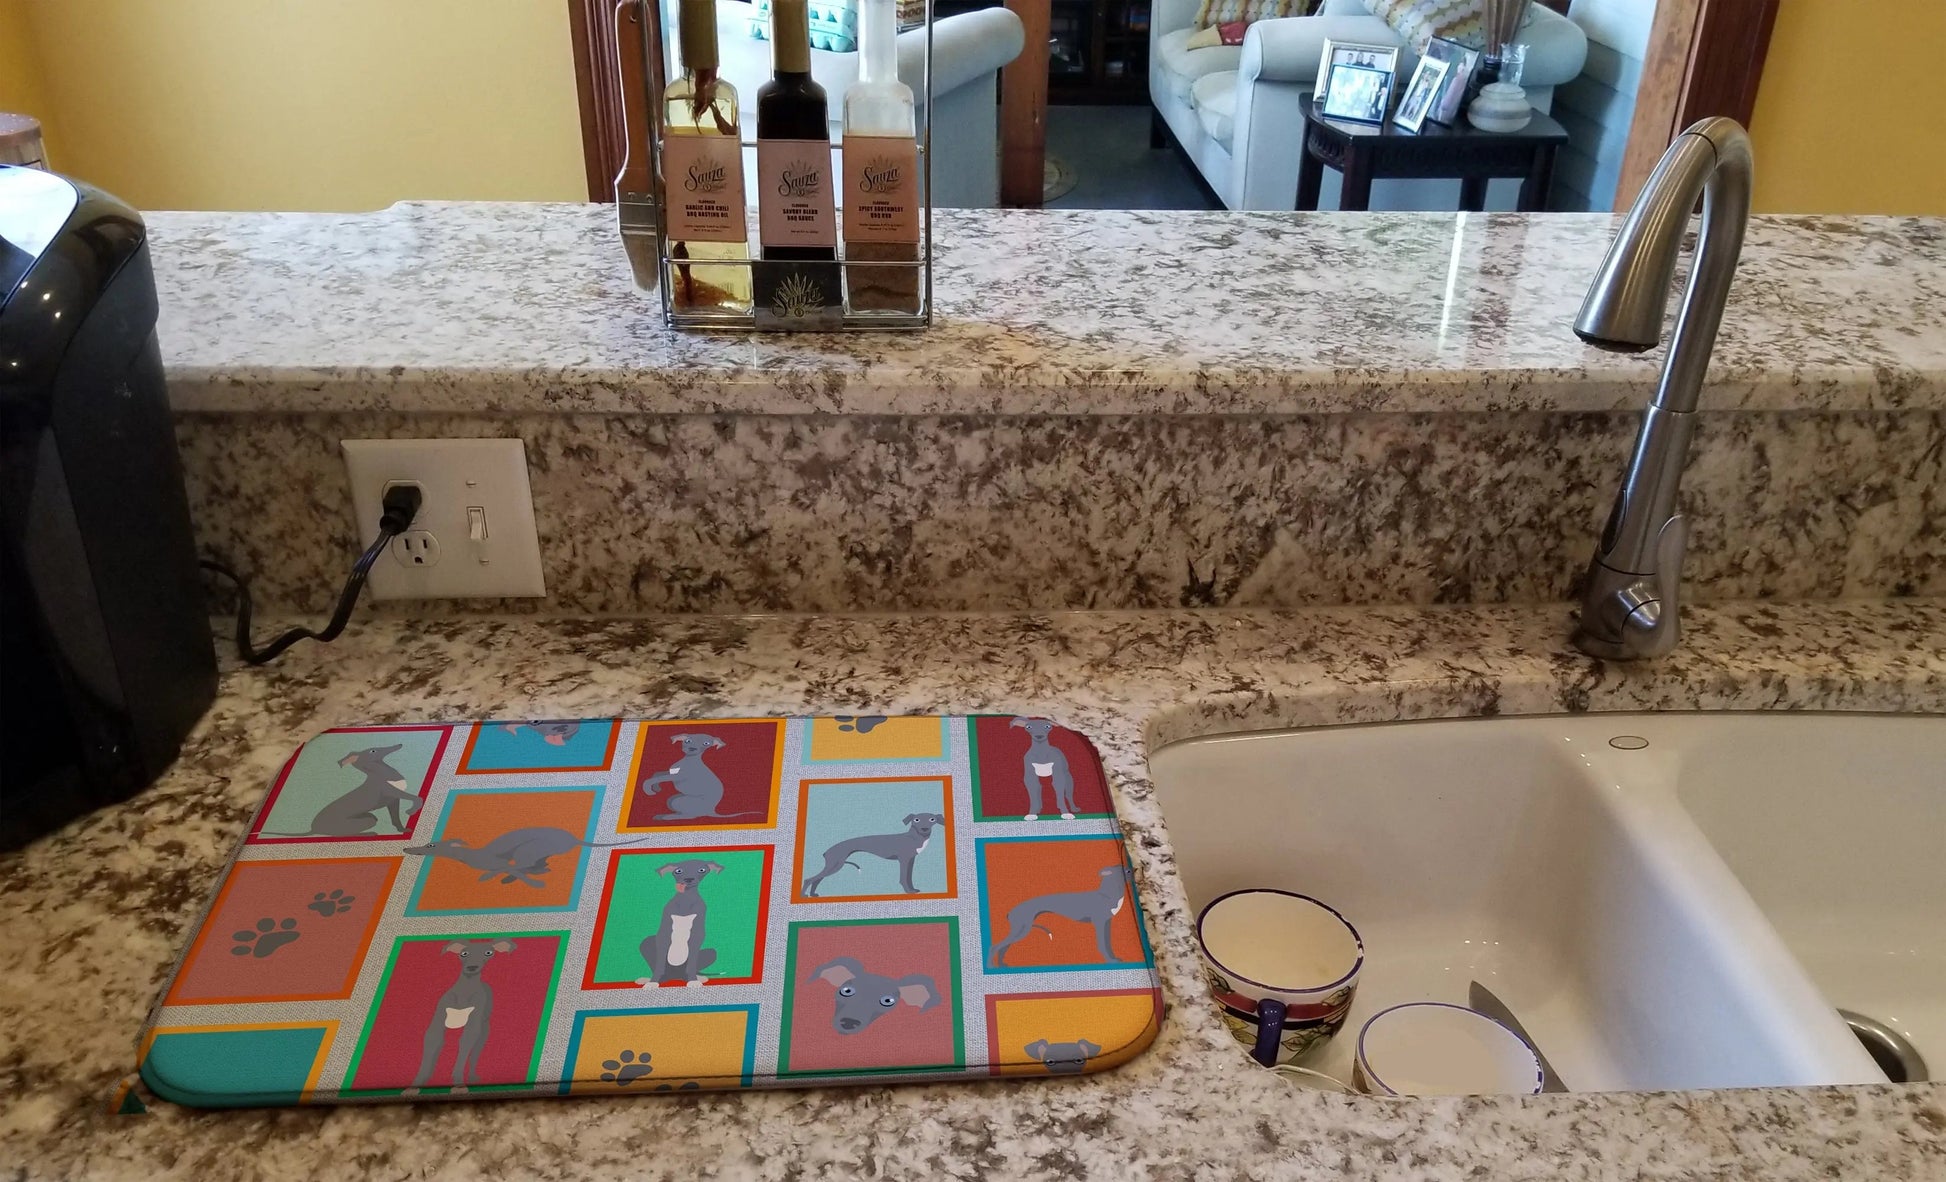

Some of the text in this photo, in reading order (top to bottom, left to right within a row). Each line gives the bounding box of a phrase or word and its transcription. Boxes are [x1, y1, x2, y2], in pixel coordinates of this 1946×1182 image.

[685, 166, 725, 191] Sauza
[778, 171, 818, 196] Sauza
[860, 167, 900, 192] Sauza
